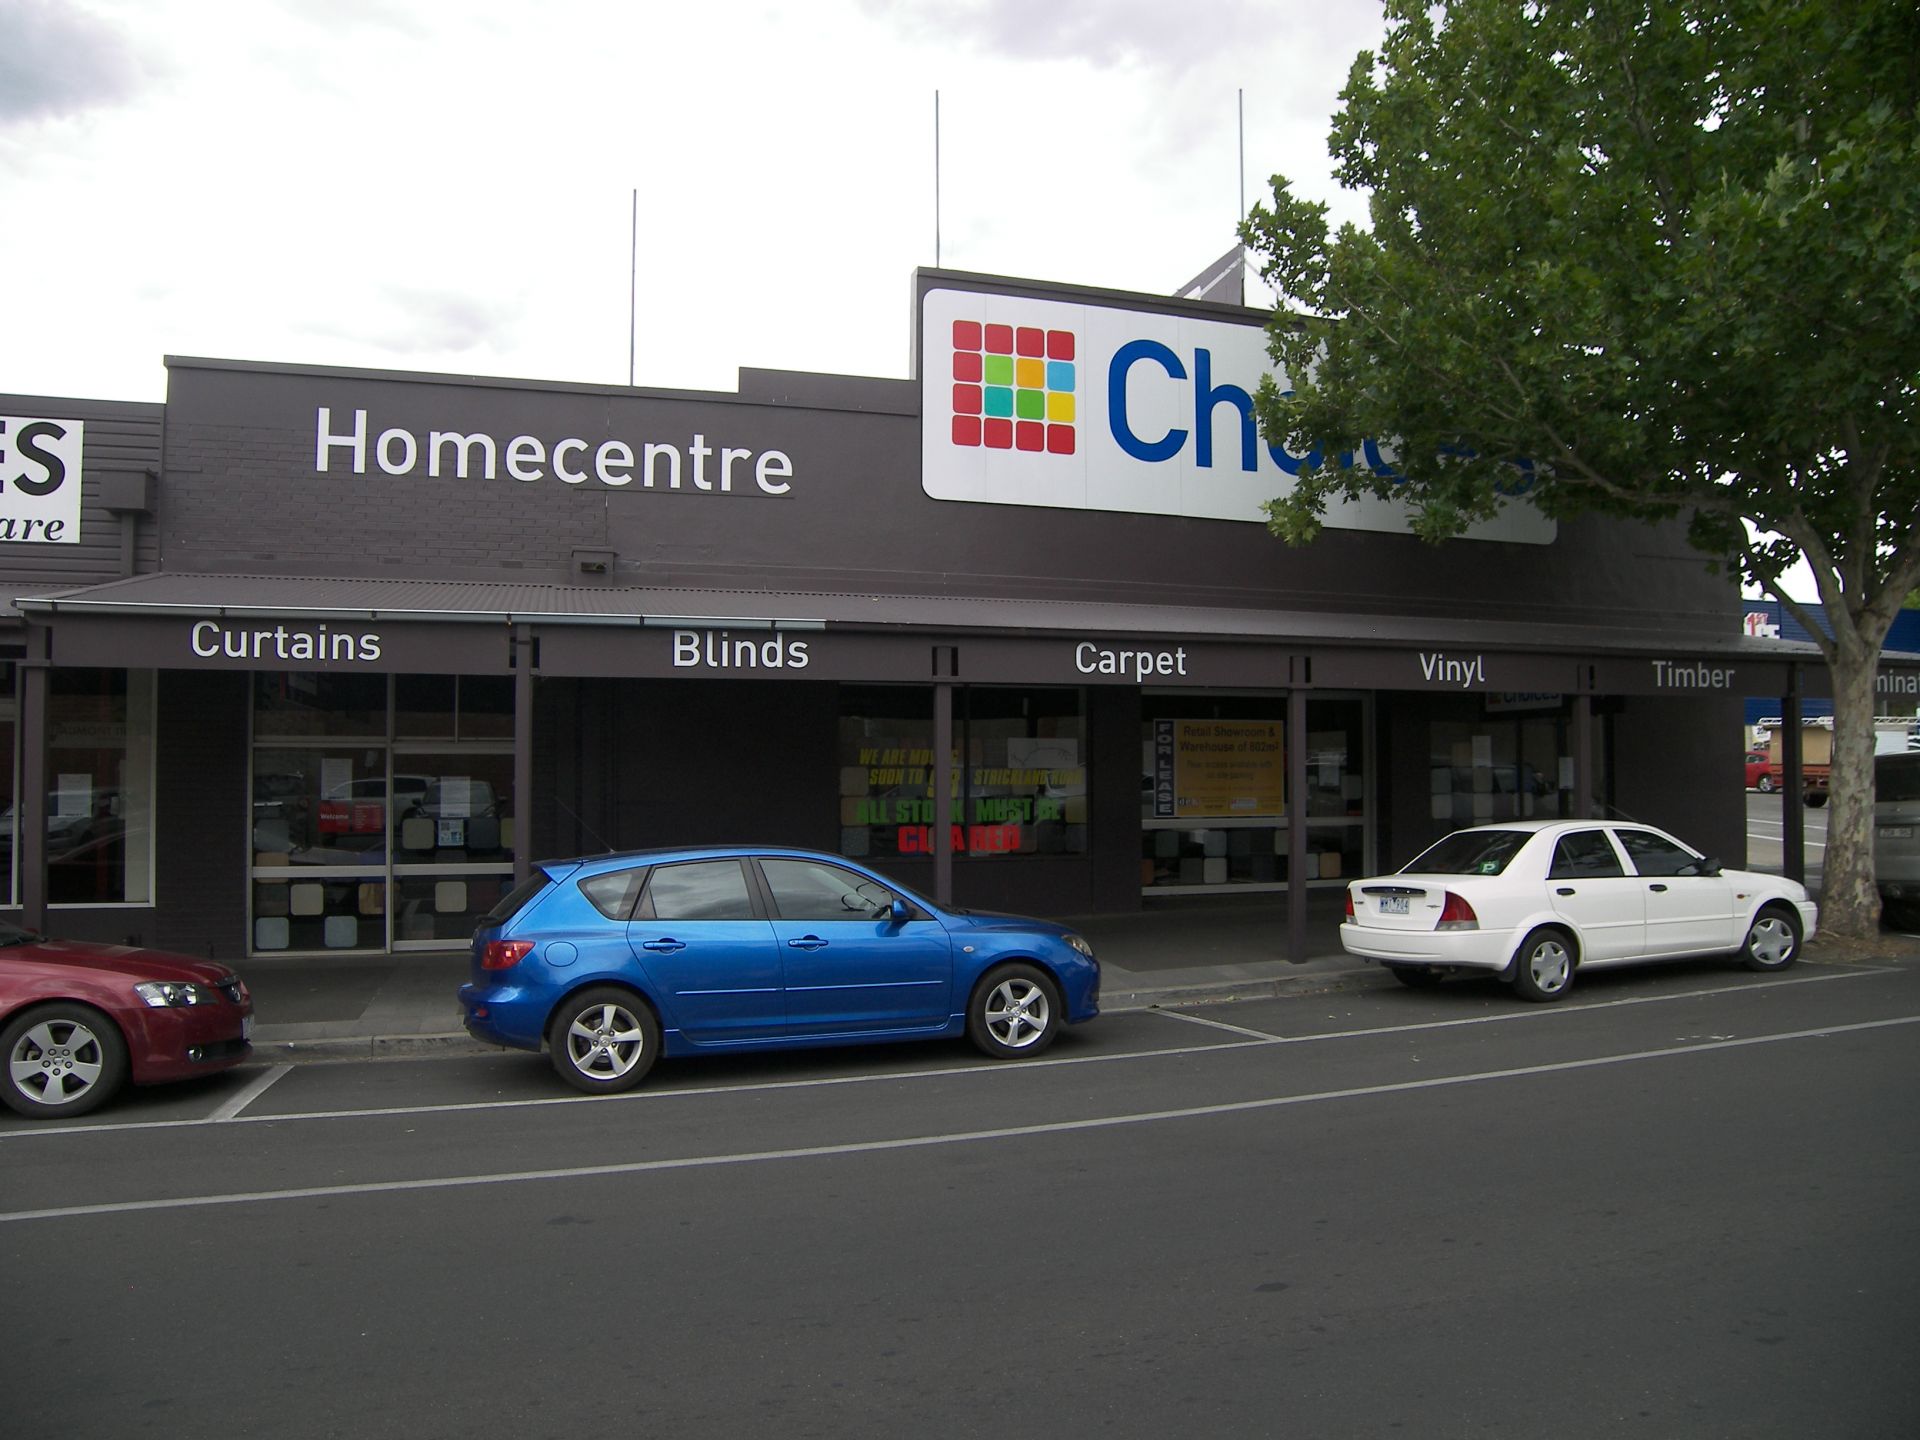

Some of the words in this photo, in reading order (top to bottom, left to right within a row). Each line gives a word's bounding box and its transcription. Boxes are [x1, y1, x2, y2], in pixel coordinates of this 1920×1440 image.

[315, 407, 793, 495] Homecentre
[191, 621, 382, 662] Curtains
[672, 630, 810, 669] Blinds
[1075, 641, 1187, 683] Carpet
[1419, 652, 1486, 689] Vinyl
[1651, 660, 1735, 689] Timber
[1184, 726, 1211, 737] Retail
[1214, 726, 1265, 737] Showroom
[859, 749, 878, 765] WE
[881, 749, 908, 765] ARE
[1180, 741, 1234, 752] Warehouse
[869, 769, 903, 785] SOON
[1158, 759, 1173, 813] LEASE
[855, 800, 890, 823] ALL
[895, 800, 964, 823] STOK
[976, 799, 1033, 822] MUST
[897, 825, 1020, 853] CLARED
